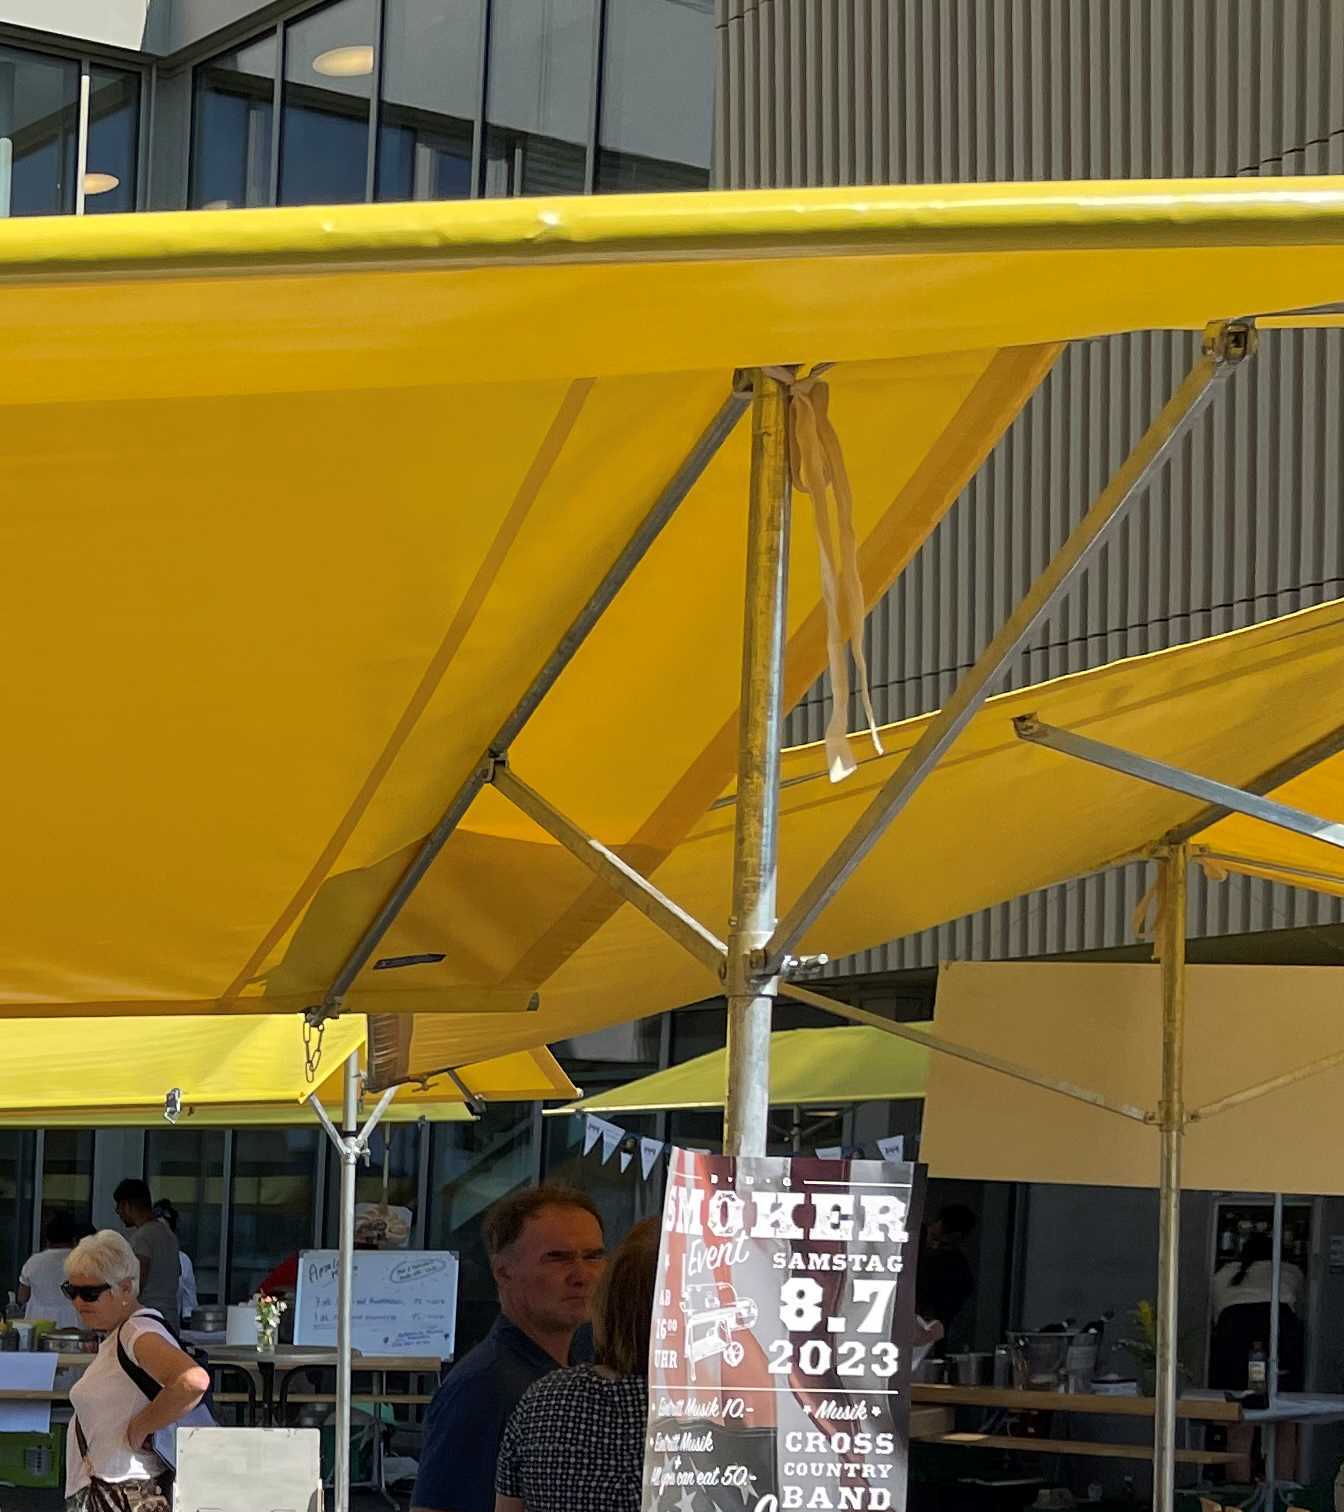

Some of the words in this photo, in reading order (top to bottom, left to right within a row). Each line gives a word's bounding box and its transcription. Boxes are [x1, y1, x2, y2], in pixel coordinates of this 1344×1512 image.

[665, 1185, 909, 1242] SMOKER
[688, 1231, 749, 1276] Event
[772, 1252, 904, 1273] SAMSTAG
[779, 1277, 897, 1333] 8.7
[654, 1352, 677, 1369] UHR
[768, 1340, 899, 1377] 2023
[685, 1397, 719, 1417] Musik
[816, 1401, 868, 1420] Musik
[785, 1431, 894, 1455] CROSS
[697, 1467, 720, 1485] eat
[783, 1462, 893, 1479] COUNTRY
[781, 1485, 892, 1511] BAND
